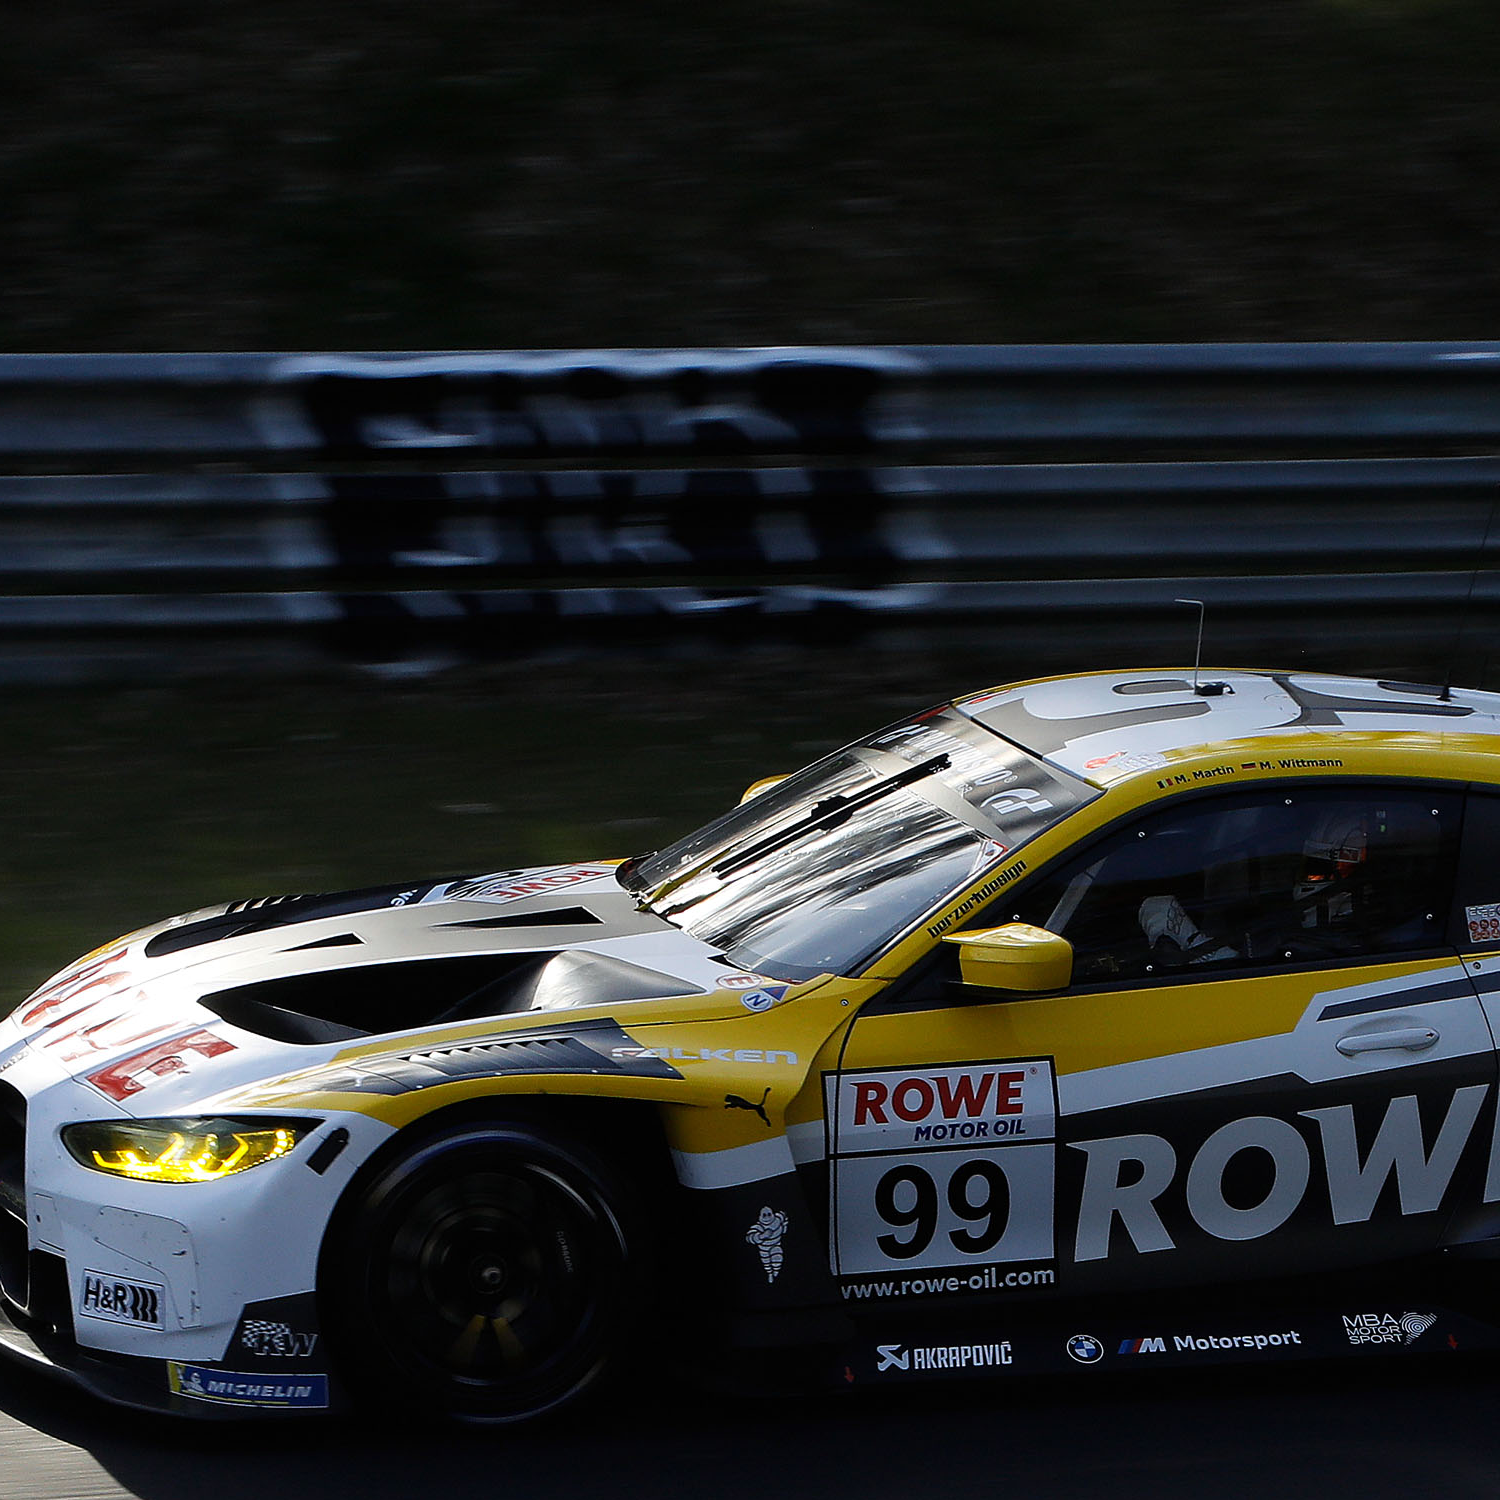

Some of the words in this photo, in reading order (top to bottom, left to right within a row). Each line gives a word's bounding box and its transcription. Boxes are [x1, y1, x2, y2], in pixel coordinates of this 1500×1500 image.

[1174, 774, 1191, 784] M.
[1193, 765, 1235, 780] Martin
[1260, 759, 1276, 770] M.
[1280, 757, 1343, 769] Wittmann
[611, 1047, 798, 1065] FALKEN
[850, 1070, 1026, 1126] ROWE
[914, 1122, 989, 1142] MOTOR
[993, 1119, 1026, 1136] OIL
[874, 1158, 1011, 1261] 99
[83, 1278, 129, 1312] H&R
[1342, 1313, 1399, 1328] MBA
[1346, 1325, 1401, 1336] MOTOR
[1174, 1330, 1301, 1354] Motorsport
[1349, 1333, 1403, 1345] SPORT
[207, 1378, 313, 1400] MICHELIN
